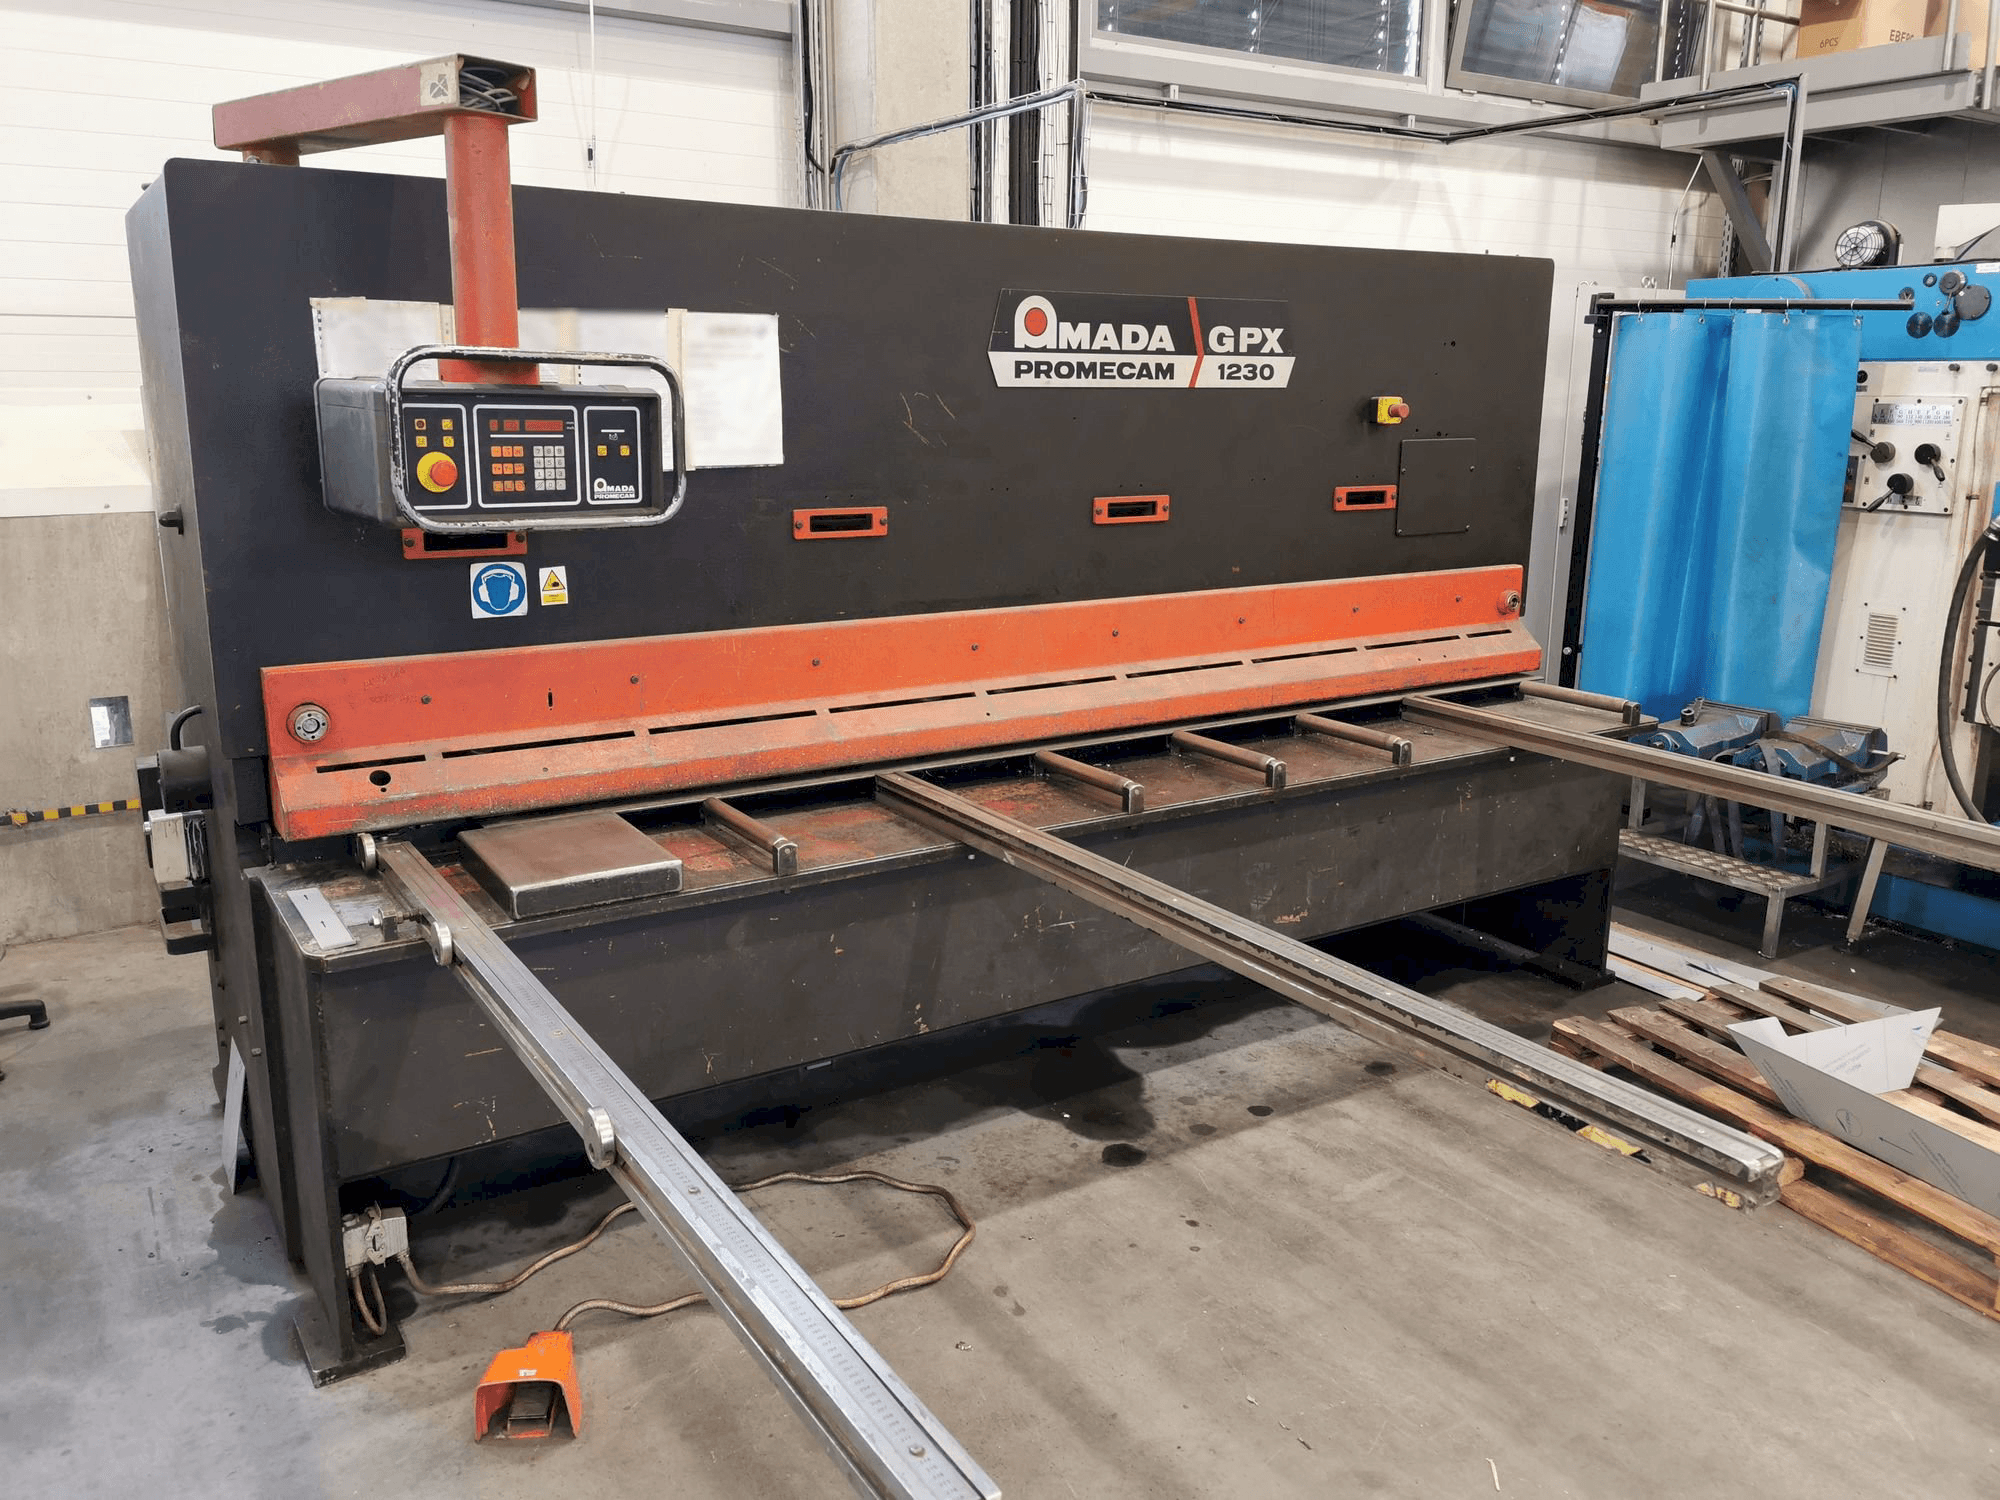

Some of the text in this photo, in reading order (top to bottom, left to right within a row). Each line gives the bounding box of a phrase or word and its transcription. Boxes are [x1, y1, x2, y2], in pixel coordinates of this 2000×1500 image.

[1819, 37, 1839, 48] 6PCS
[1014, 295, 1285, 354] AMADA GPX
[1014, 360, 1275, 381] PROMECAM 1230
[593, 477, 635, 492] AMADA
